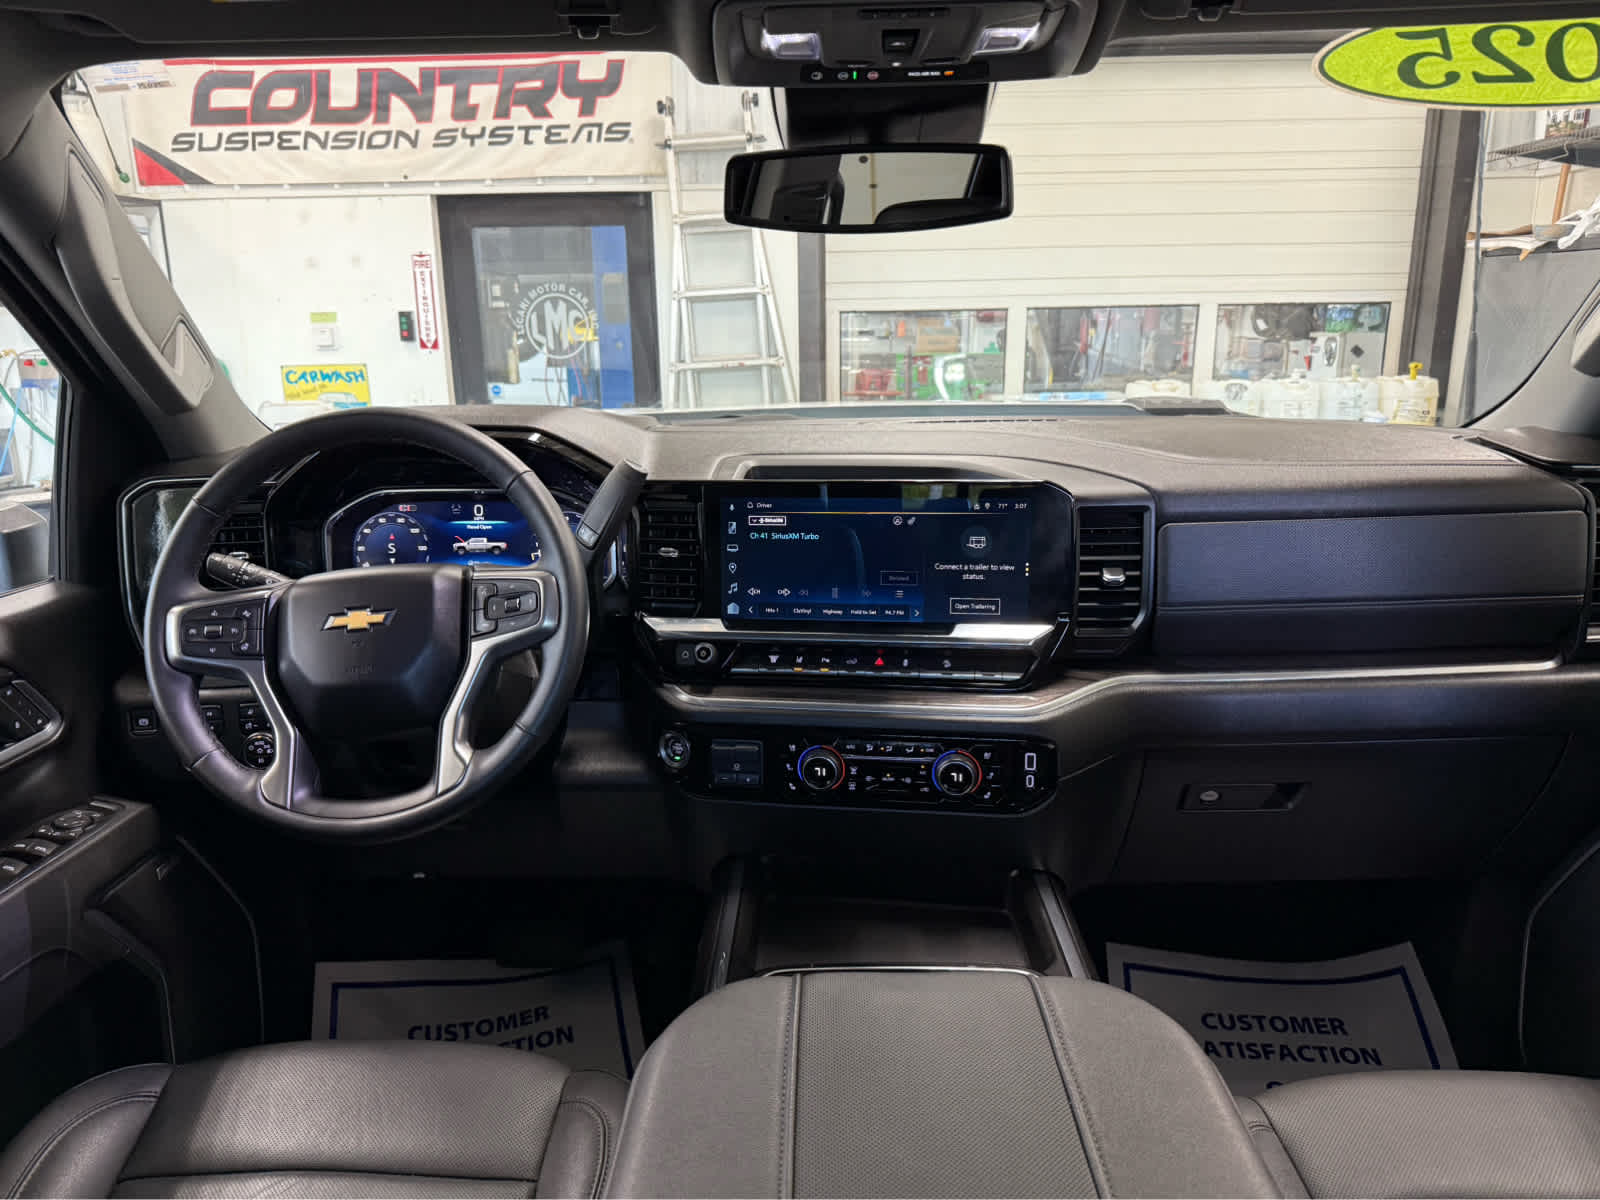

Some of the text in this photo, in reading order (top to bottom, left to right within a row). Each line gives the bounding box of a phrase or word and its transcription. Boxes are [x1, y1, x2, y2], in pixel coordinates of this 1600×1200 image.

[190, 59, 626, 126] COUNTRY
[171, 128, 420, 153] SUSPENSION
[413, 260, 431, 269] FIRE
[528, 282, 566, 300] MOTOR
[530, 299, 585, 351] LMC
[473, 503, 484, 517] 0
[749, 532, 820, 541] Ch 41 SiriusXM Turbo
[387, 543, 397, 554] S
[934, 562, 962, 571] Connect
[969, 563, 989, 571] trailer
[990, 563, 999, 571] to
[1000, 564, 1015, 572] view
[954, 603, 996, 611] Open Trailering
[814, 767, 827, 777] 71
[950, 772, 963, 782] 71
[408, 1005, 551, 1042] CUSTOMER
[1201, 1012, 1349, 1036] CUSTOMER
[1204, 1040, 1383, 1066] ATISFACTION
